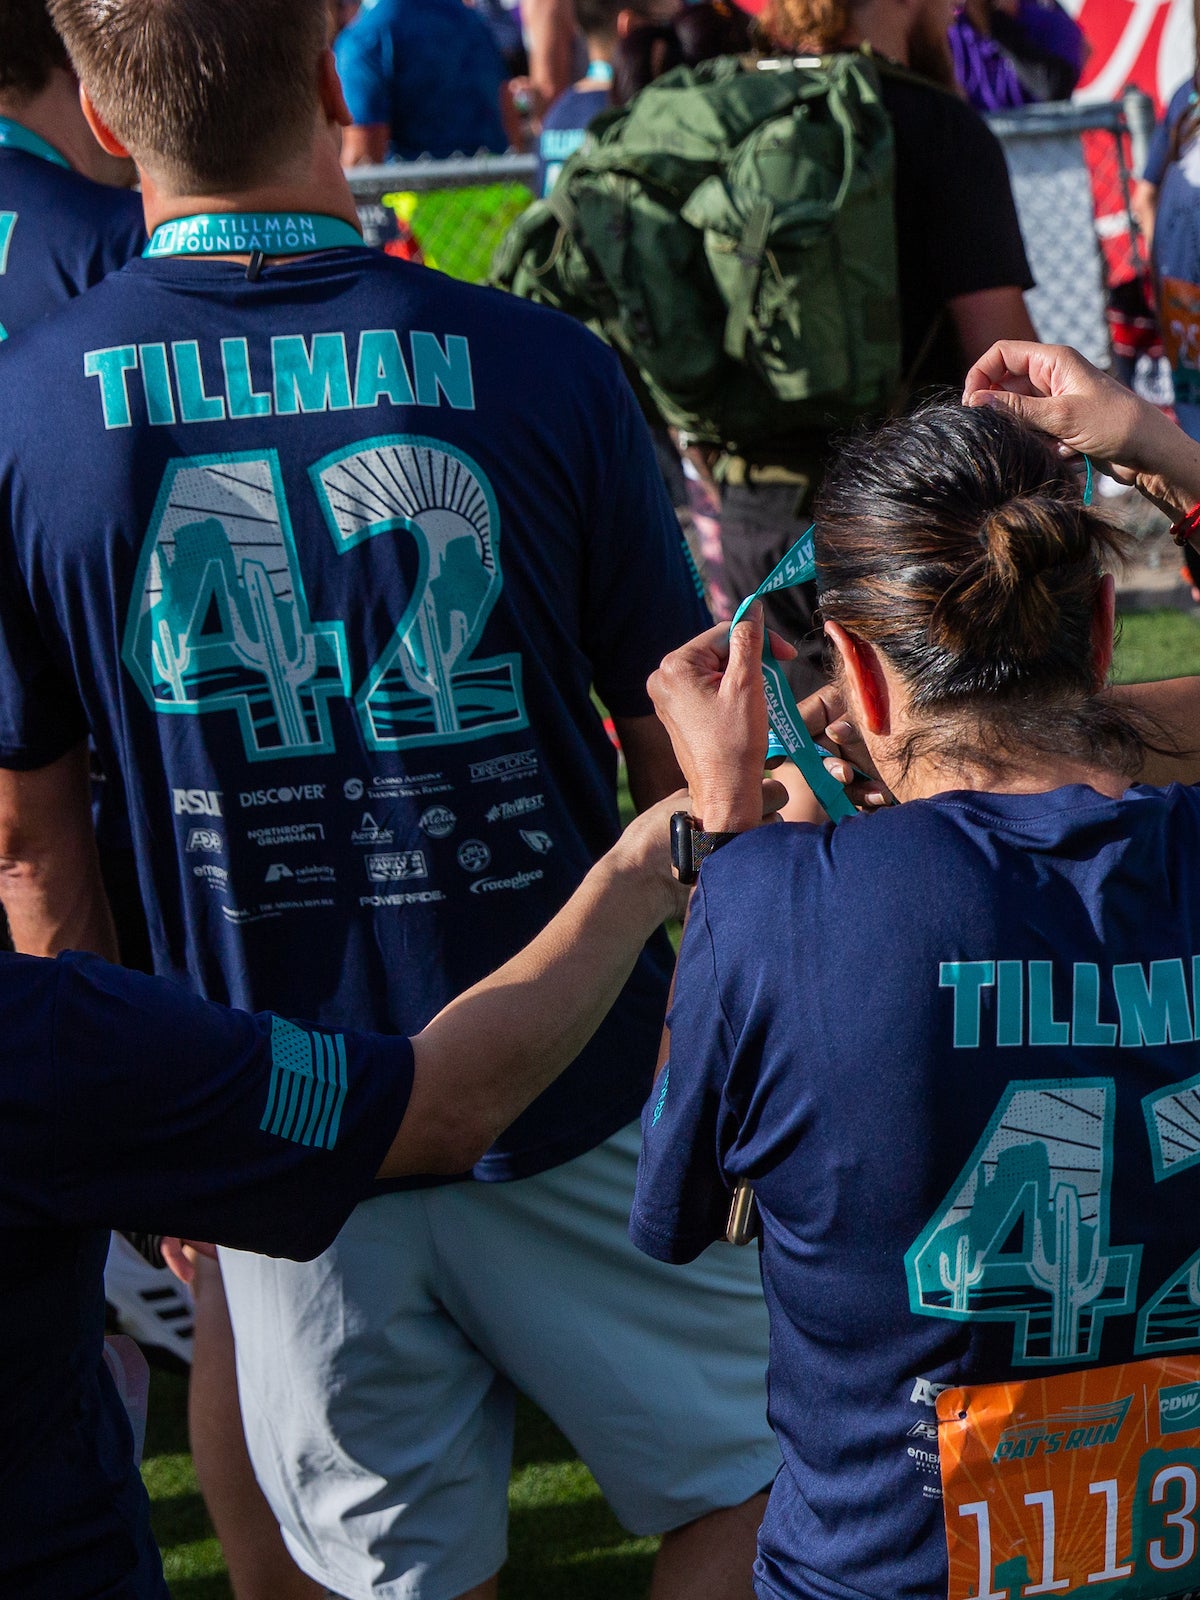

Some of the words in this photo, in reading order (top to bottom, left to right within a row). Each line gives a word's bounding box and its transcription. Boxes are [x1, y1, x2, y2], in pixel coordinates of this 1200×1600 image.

[178, 219, 210, 236] PAT
[218, 216, 315, 234] TILLMAN
[176, 231, 317, 252] FOUNDATION
[84, 329, 476, 430] TILLMAN
[120, 432, 530, 763] 42
[777, 707, 802, 750] FAMILY
[172, 788, 223, 817] ASU
[239, 784, 326, 808] DISCOVER
[1158, 1390, 1199, 1415] CDW
[992, 1430, 1061, 1465] PAT'S
[1064, 1419, 1121, 1453] RUN
